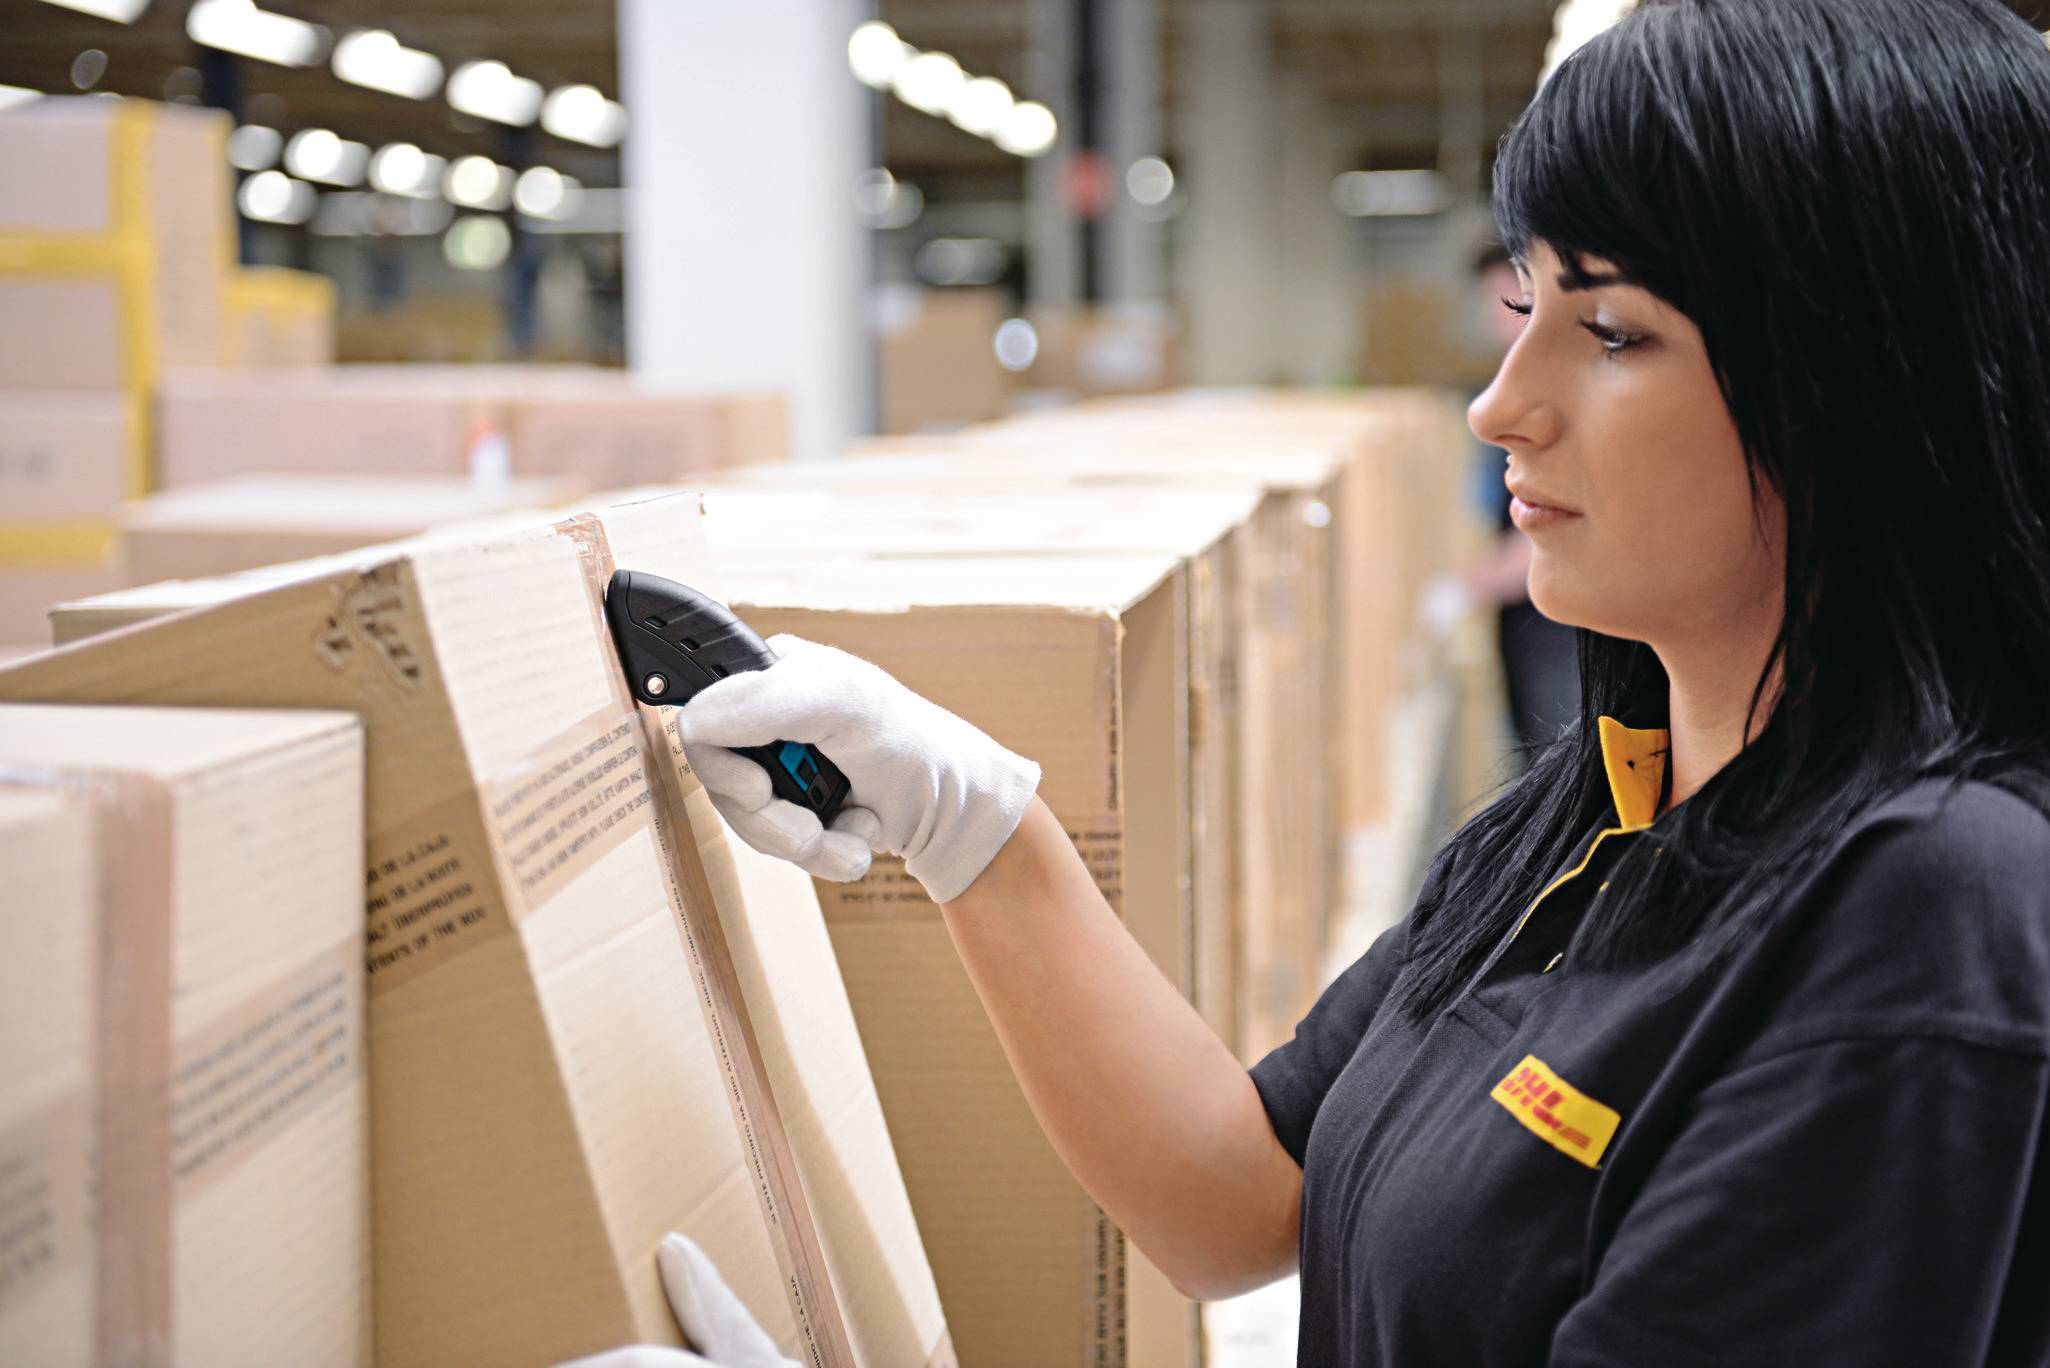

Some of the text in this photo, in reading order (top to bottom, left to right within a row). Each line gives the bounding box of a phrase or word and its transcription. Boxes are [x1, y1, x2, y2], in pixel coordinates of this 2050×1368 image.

[730, 1076, 742, 1103] SIDO
[744, 1124, 763, 1181] PRECINTO
[762, 1183, 774, 1212] ESTE
